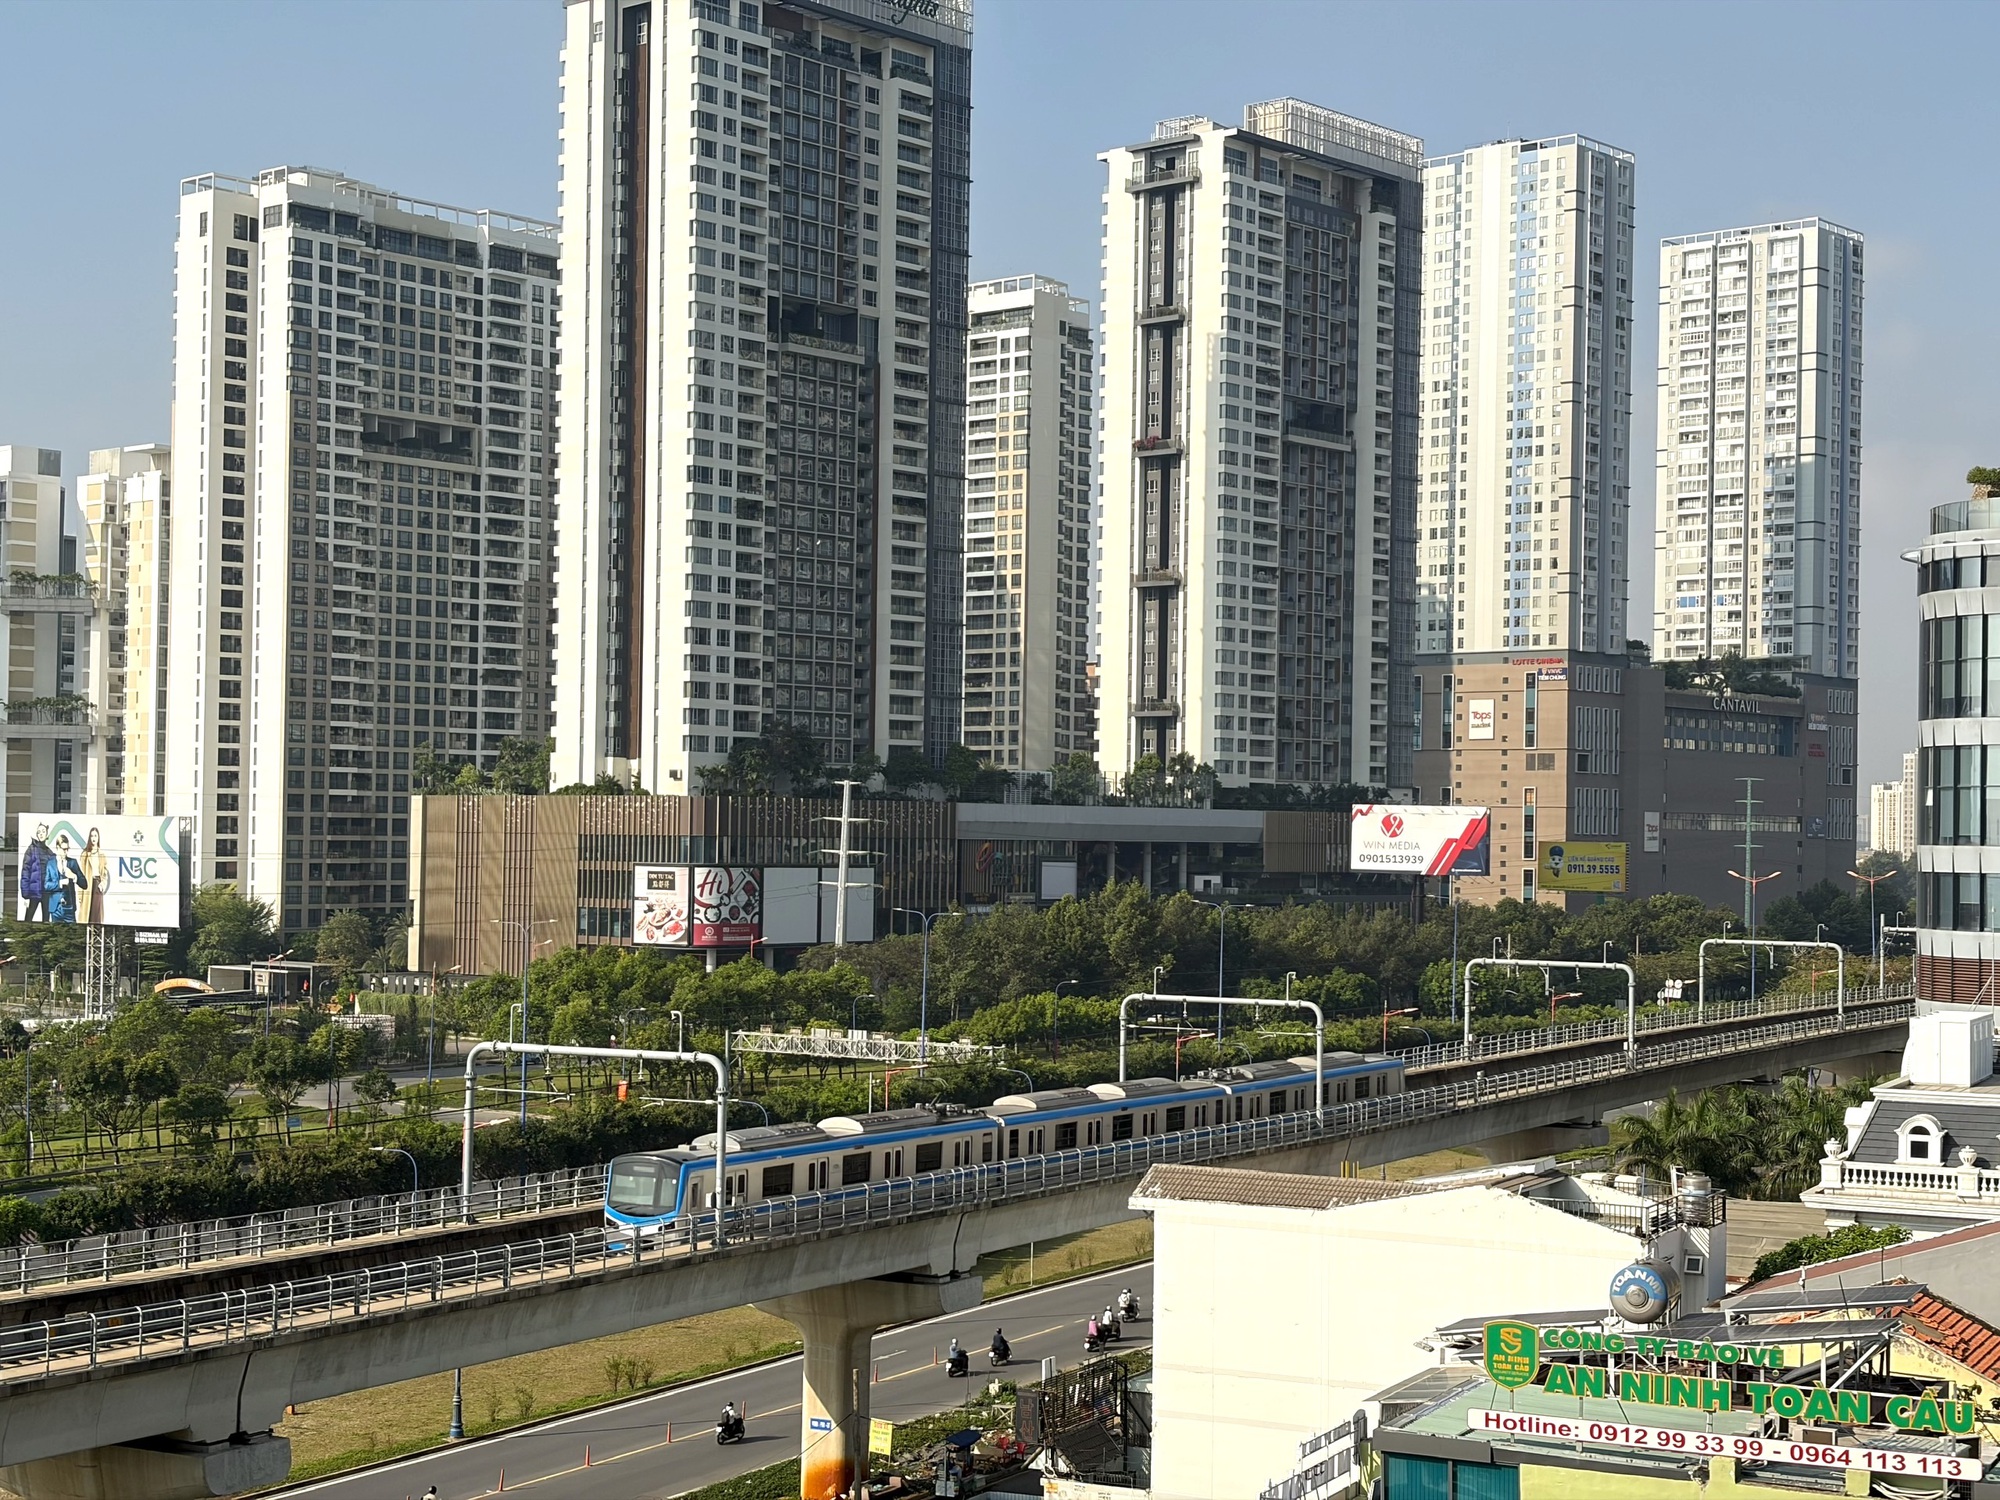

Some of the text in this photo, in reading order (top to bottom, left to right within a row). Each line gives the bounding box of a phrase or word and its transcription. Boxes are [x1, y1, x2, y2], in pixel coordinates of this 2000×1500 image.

[1512, 657, 1565, 666] LOTTE CINEMA
[1713, 697, 1760, 713] CANTAVIL
[1471, 711, 1491, 722] Tops
[1363, 841, 1420, 850] WIN MEDIA
[1359, 853, 1424, 864] 0901513939
[119, 856, 157, 879] NBC
[1567, 863, 1620, 874] 0911.39.5555
[697, 869, 724, 898] Hi
[1543, 1325, 1785, 1377] CÔNG TY BẢO VỆ
[1543, 1363, 1975, 1434] AN NINH TOÀN CẦU
[1484, 1412, 1580, 1438] Hotline:
[1589, 1424, 1648, 1445] 0912
[1657, 1431, 1686, 1449] 99
[1695, 1435, 1725, 1452] 33
[1733, 1439, 1764, 1457] 99
[1790, 1444, 1852, 1466] 0964
[1863, 1452, 1906, 1471] 113
[1918, 1457, 1962, 1476] 113
